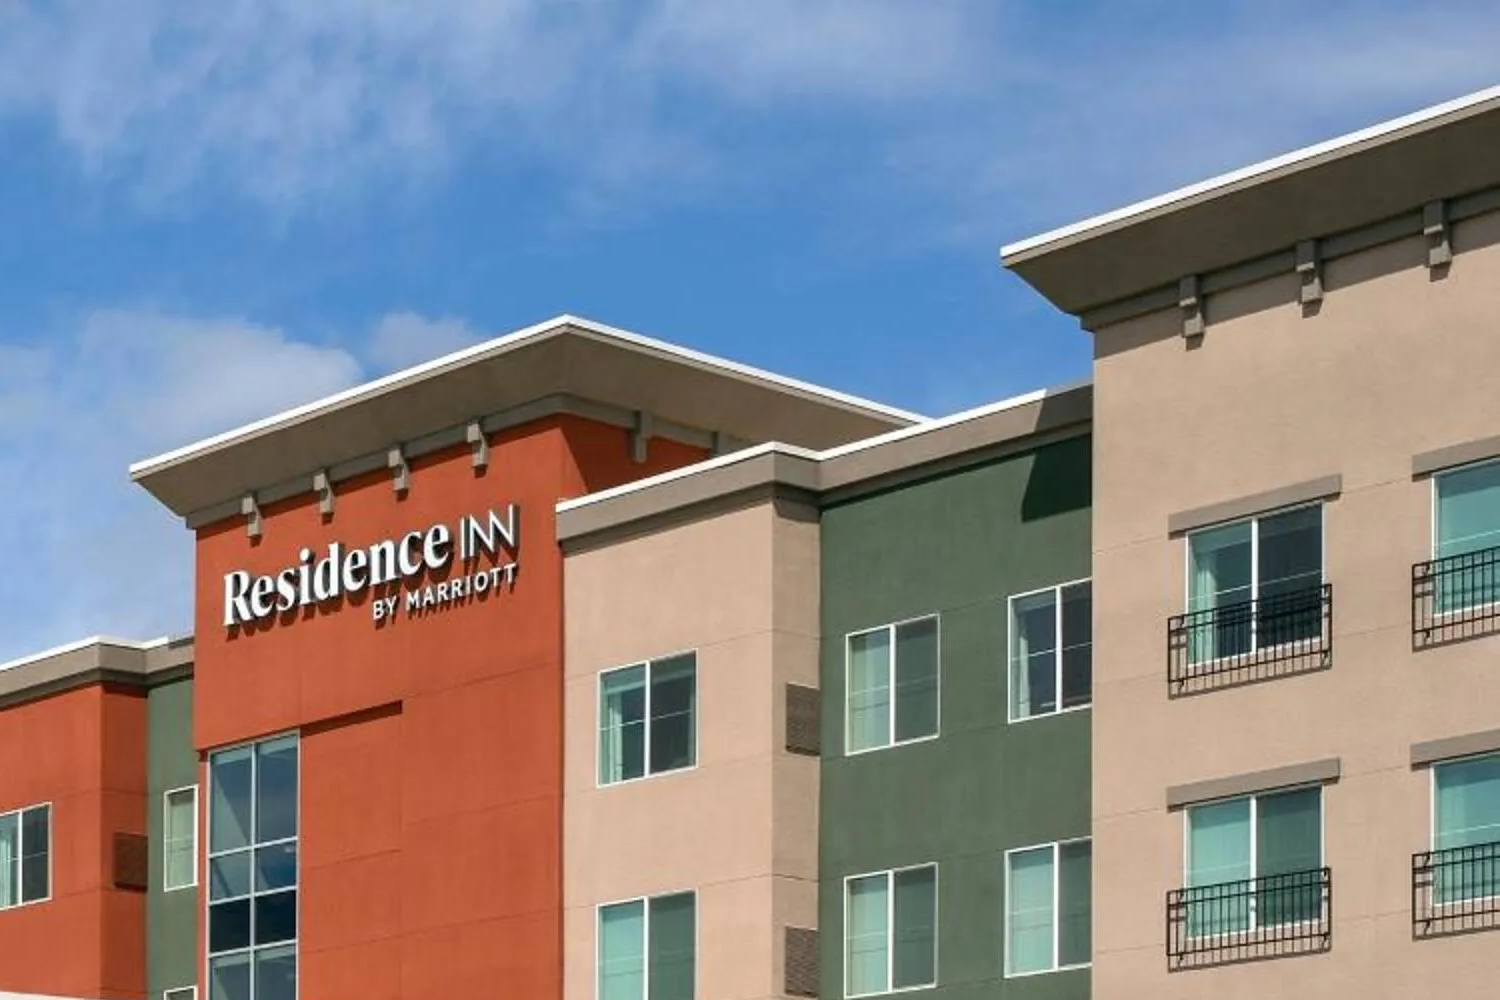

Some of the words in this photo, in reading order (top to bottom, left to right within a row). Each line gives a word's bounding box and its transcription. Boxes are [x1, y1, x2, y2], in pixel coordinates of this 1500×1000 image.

[223, 523, 449, 626] Residence
[460, 504, 515, 559] INN
[372, 597, 397, 620] BY
[406, 563, 517, 611] MARRIOTT
